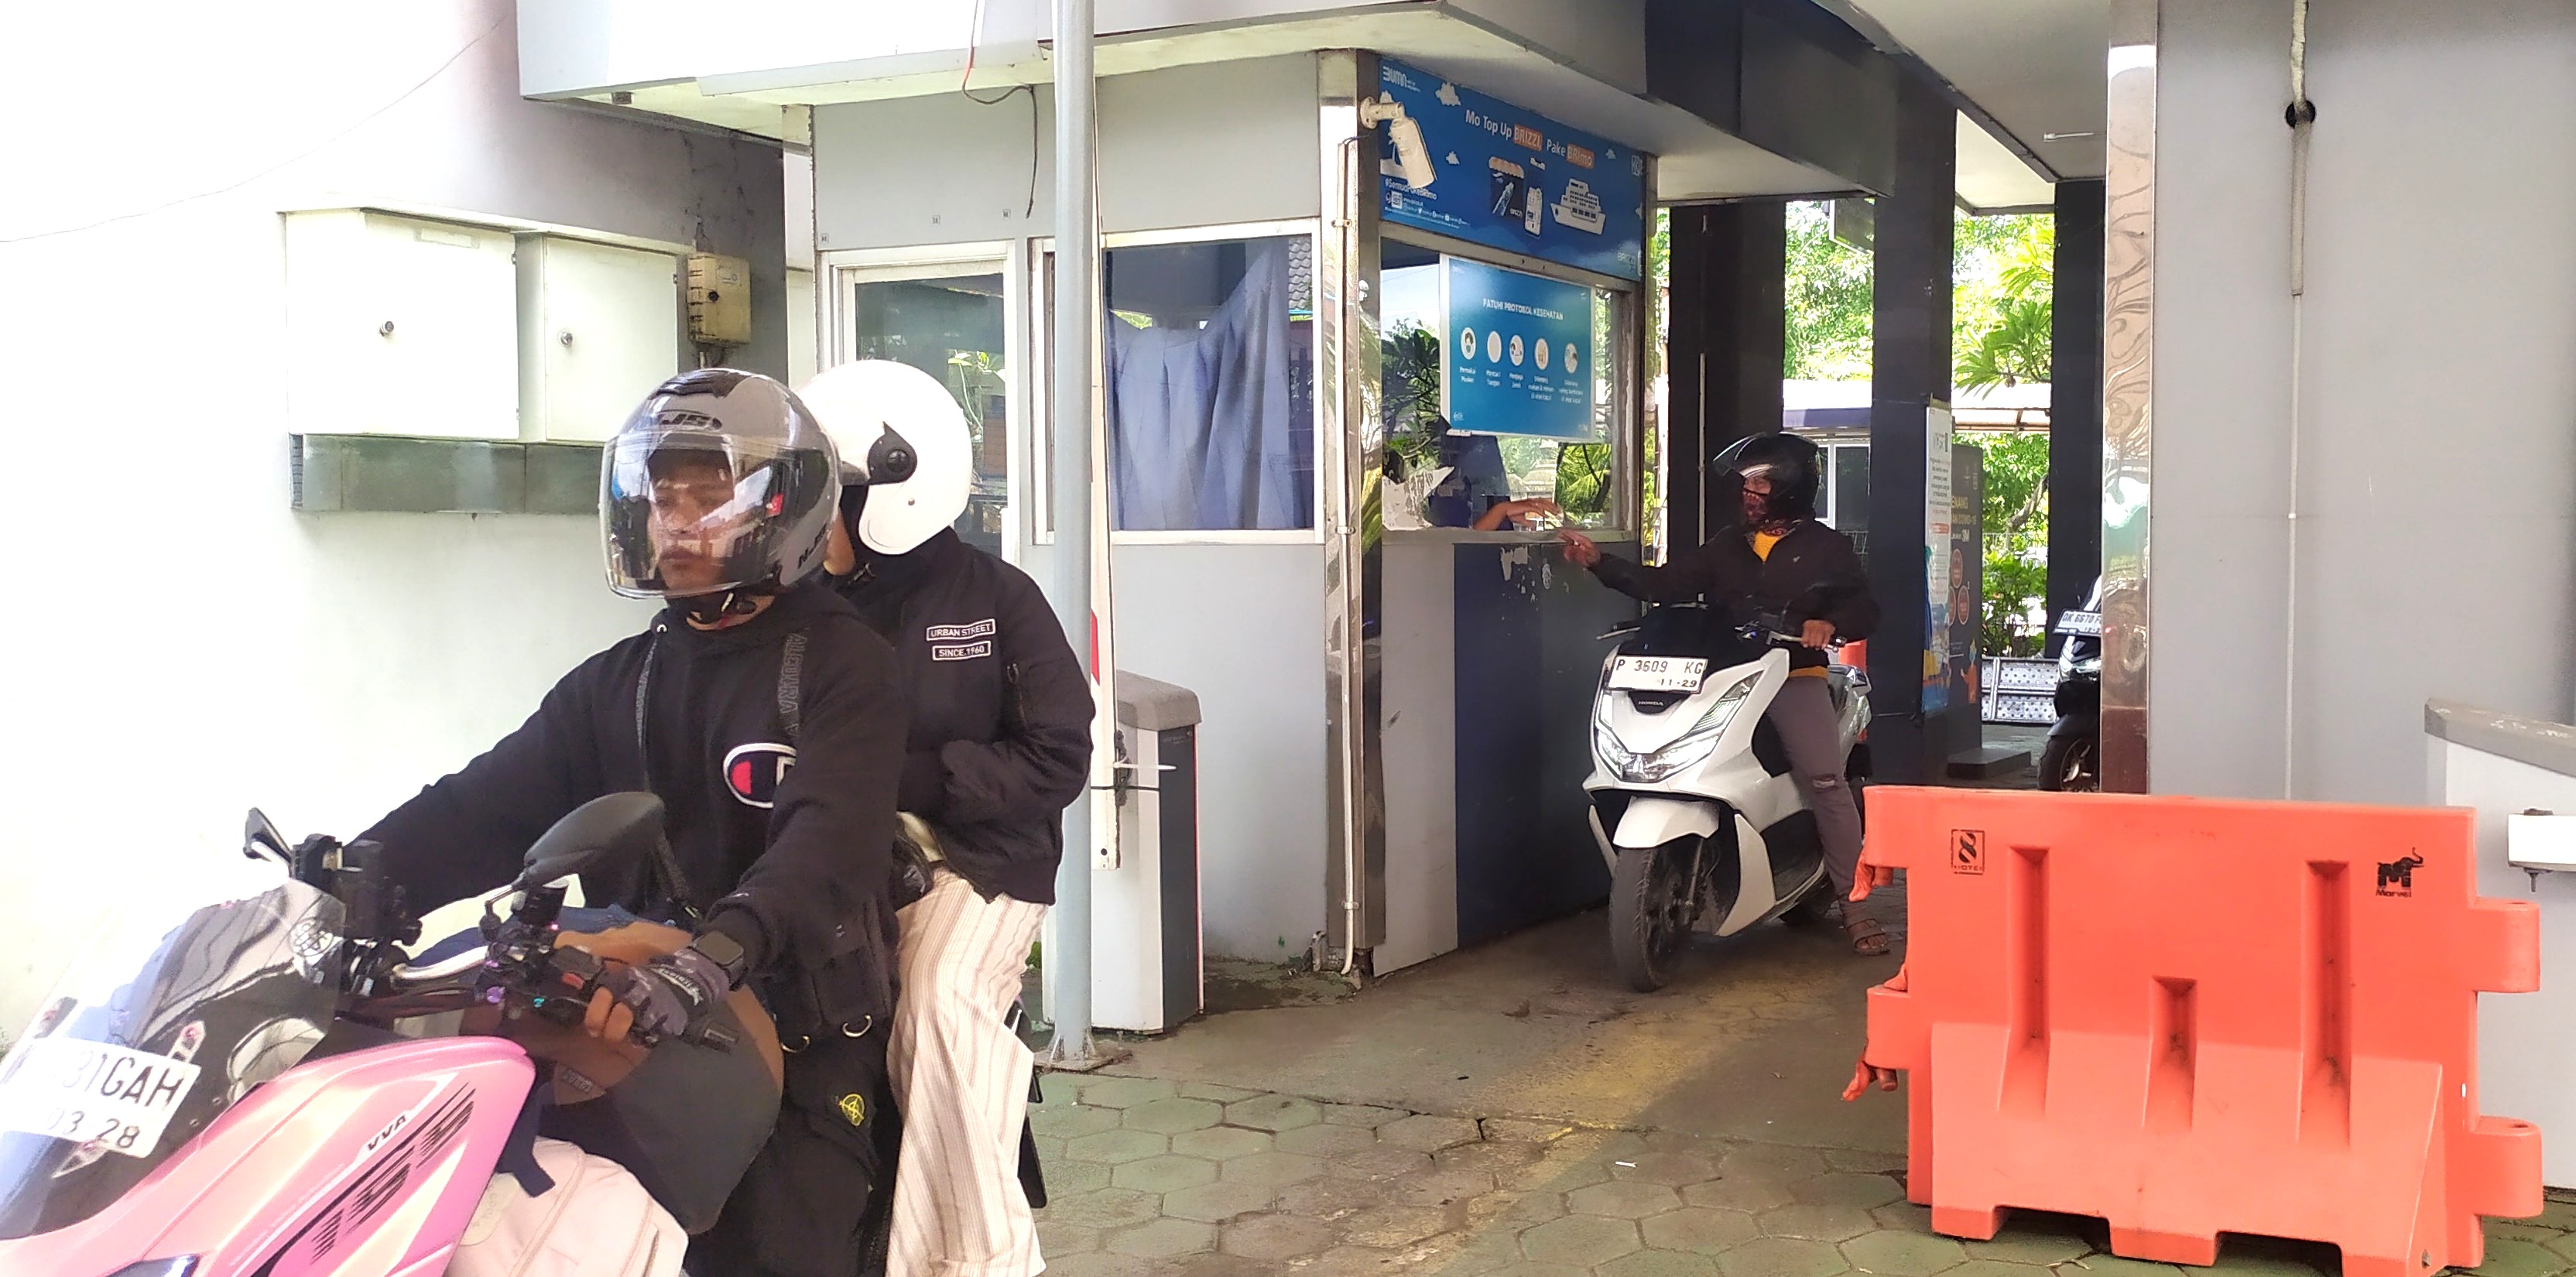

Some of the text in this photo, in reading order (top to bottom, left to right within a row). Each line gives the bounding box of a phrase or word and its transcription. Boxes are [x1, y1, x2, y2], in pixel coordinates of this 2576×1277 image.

[1465, 109, 1480, 126] Mo
[1482, 115, 1498, 136] Top
[1500, 122, 1512, 141] Up
[1547, 139, 1565, 156] Pake
[1482, 298, 1564, 320] PATUHI PROTOKOL KESEHATAN
[930, 623, 991, 637] URBAN STREET
[938, 645, 985, 657] SINCE.1960
[1616, 659, 1704, 675] P 3609 KG
[367, 1114, 406, 1151] VVA
